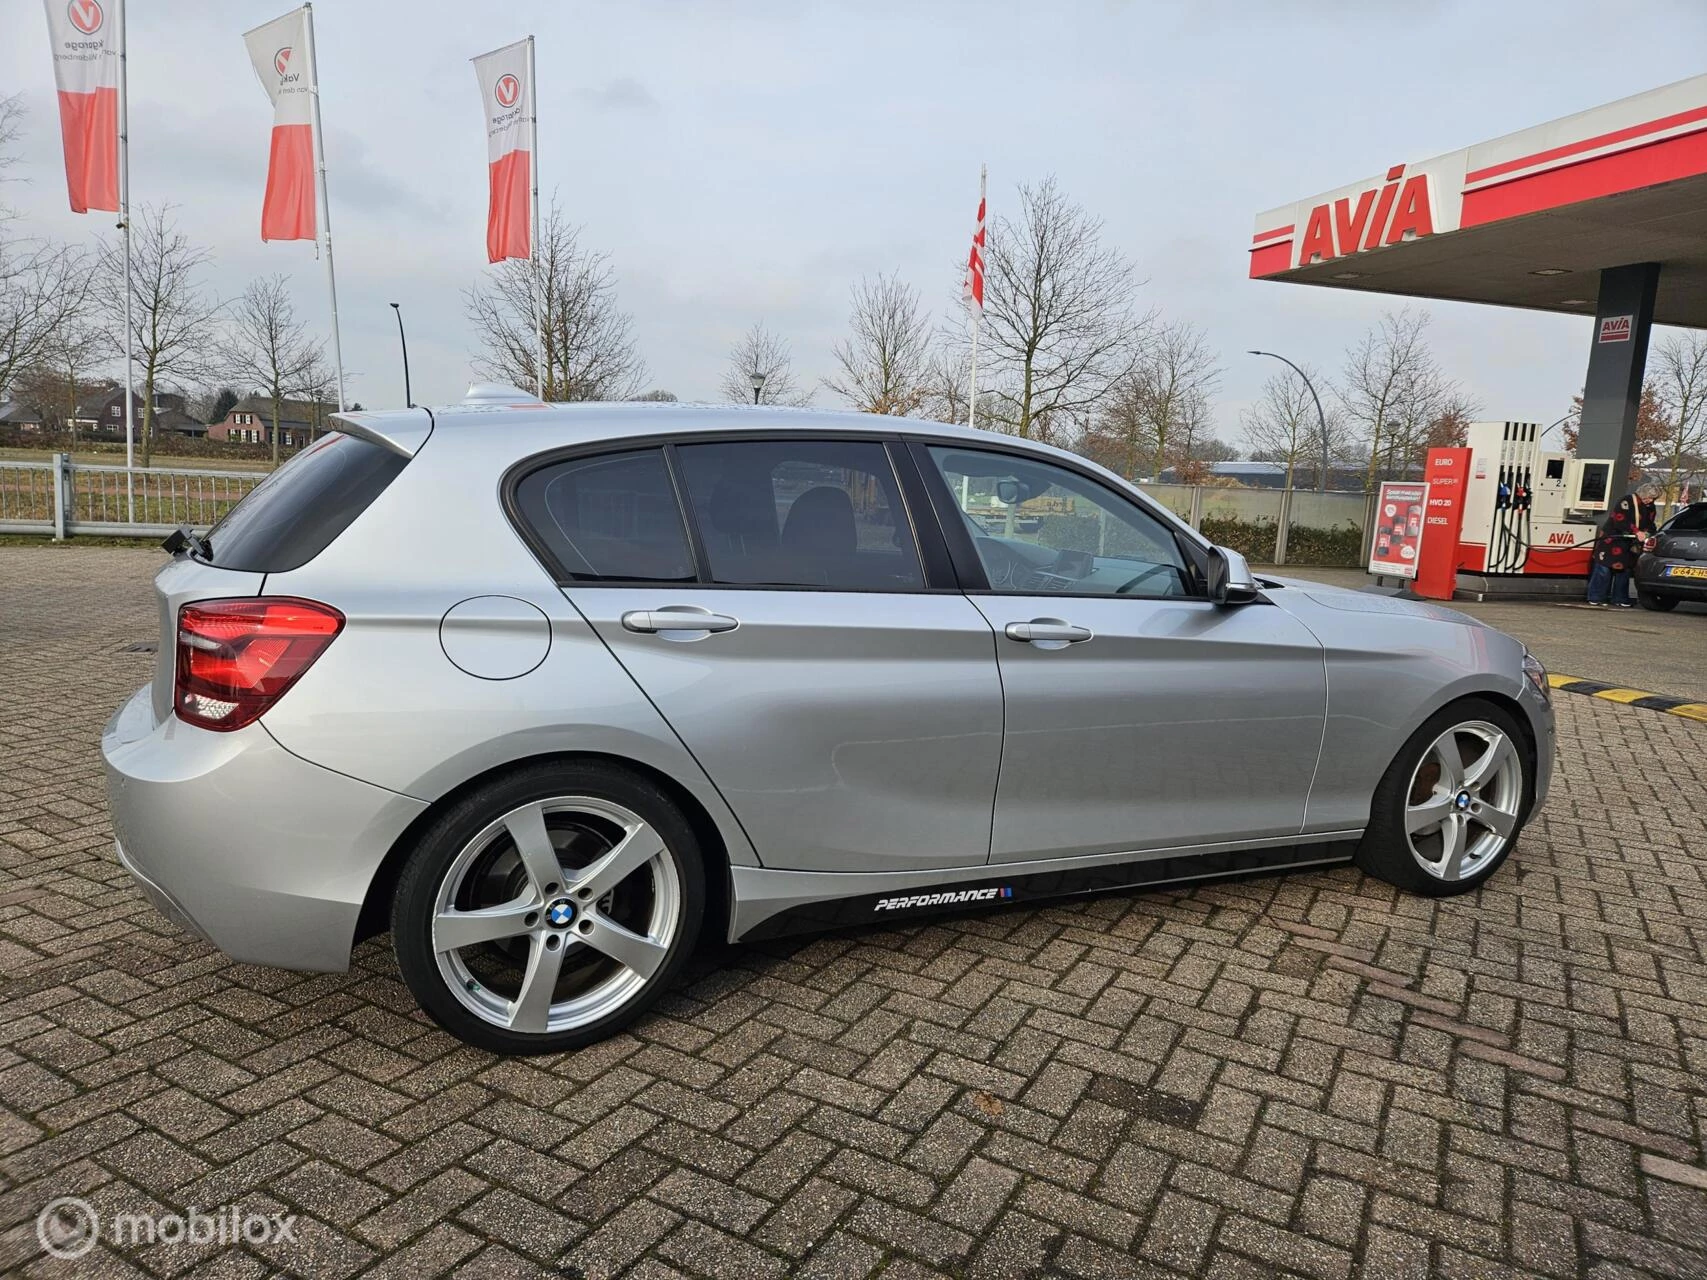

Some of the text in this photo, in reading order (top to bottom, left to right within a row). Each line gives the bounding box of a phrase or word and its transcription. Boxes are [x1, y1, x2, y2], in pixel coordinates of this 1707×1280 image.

[1298, 163, 1434, 267] AVIA
[1602, 317, 1630, 332] AVIA
[1435, 458, 1453, 466] EURO
[1427, 516, 1448, 525] DIESEL
[1548, 530, 1575, 544] AVIA
[874, 888, 998, 911] PERFORMANCE
